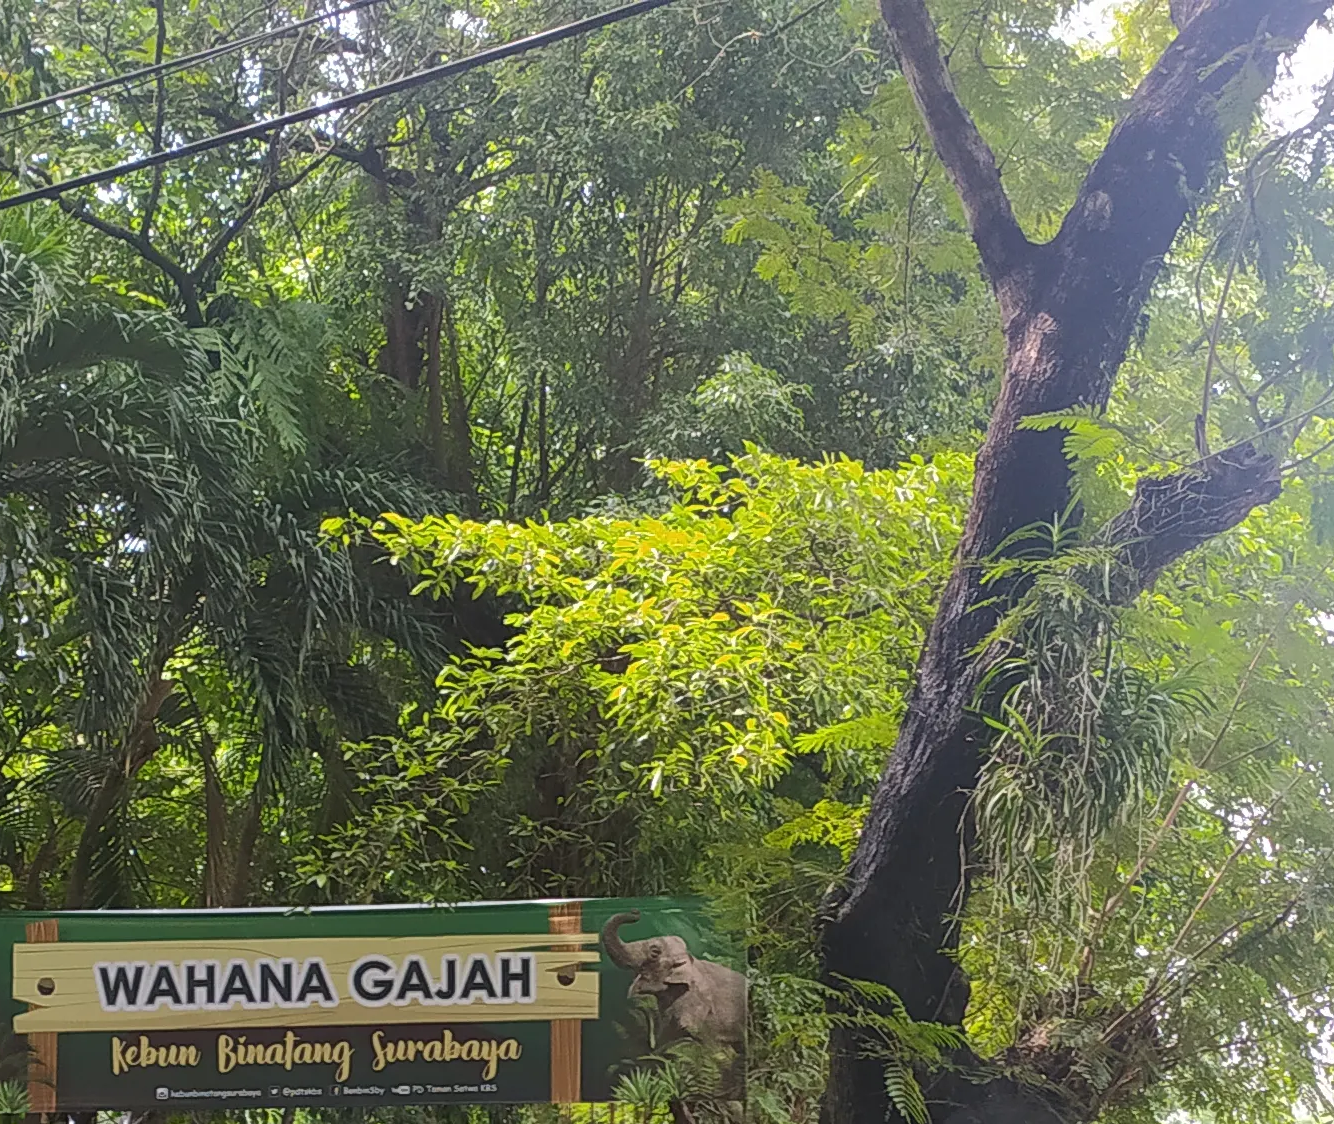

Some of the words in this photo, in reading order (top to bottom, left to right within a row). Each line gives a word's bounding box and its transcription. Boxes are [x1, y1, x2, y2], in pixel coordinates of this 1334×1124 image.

[97, 961, 335, 1007] WAHANA
[353, 956, 532, 1002] GAJAH
[111, 1035, 202, 1076] Kebun
[218, 1031, 355, 1083] Binatang
[371, 1029, 524, 1082] Surabaya
